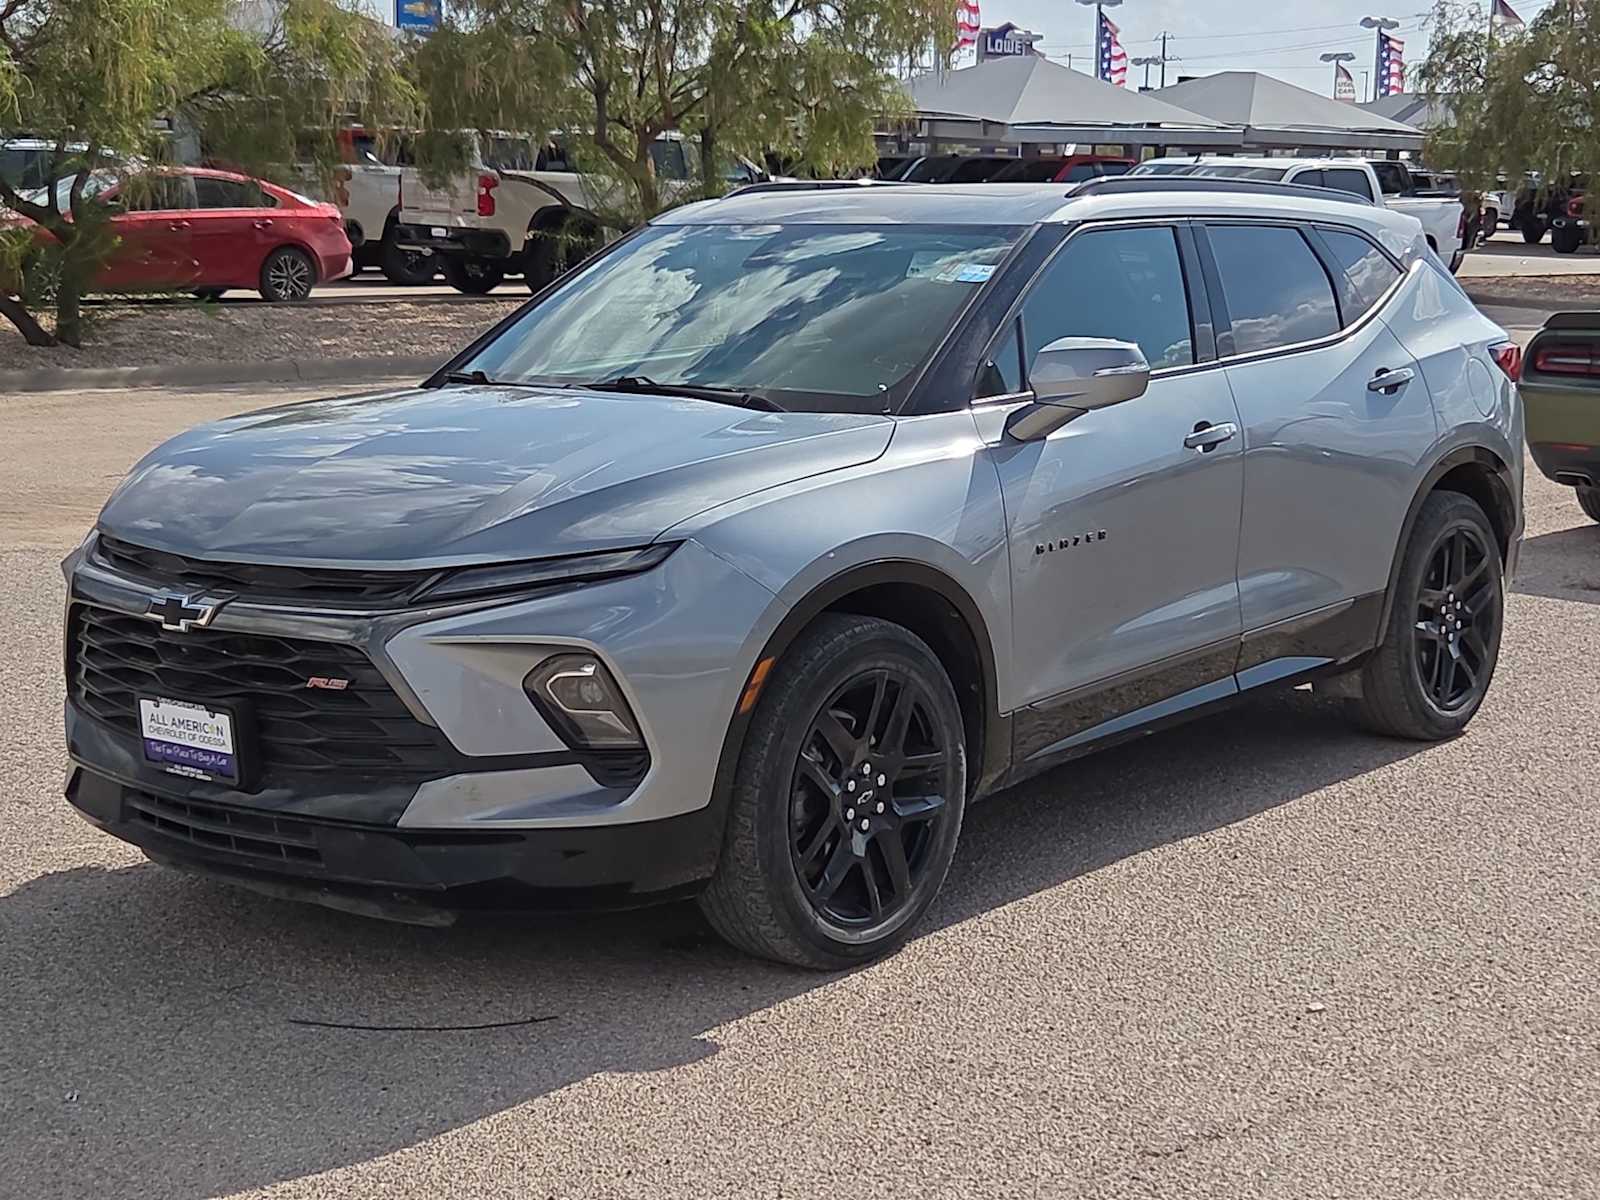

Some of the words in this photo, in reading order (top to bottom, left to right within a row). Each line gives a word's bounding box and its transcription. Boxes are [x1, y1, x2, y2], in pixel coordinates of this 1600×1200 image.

[987, 36, 1022, 54] LOWE
[1035, 529, 1107, 555] BLAZER
[306, 677, 349, 689] RS
[150, 713, 168, 726] ALL
[148, 725, 187, 740] CHEVROLET
[188, 733, 196, 742] OF
[199, 735, 226, 747] ODESSA
